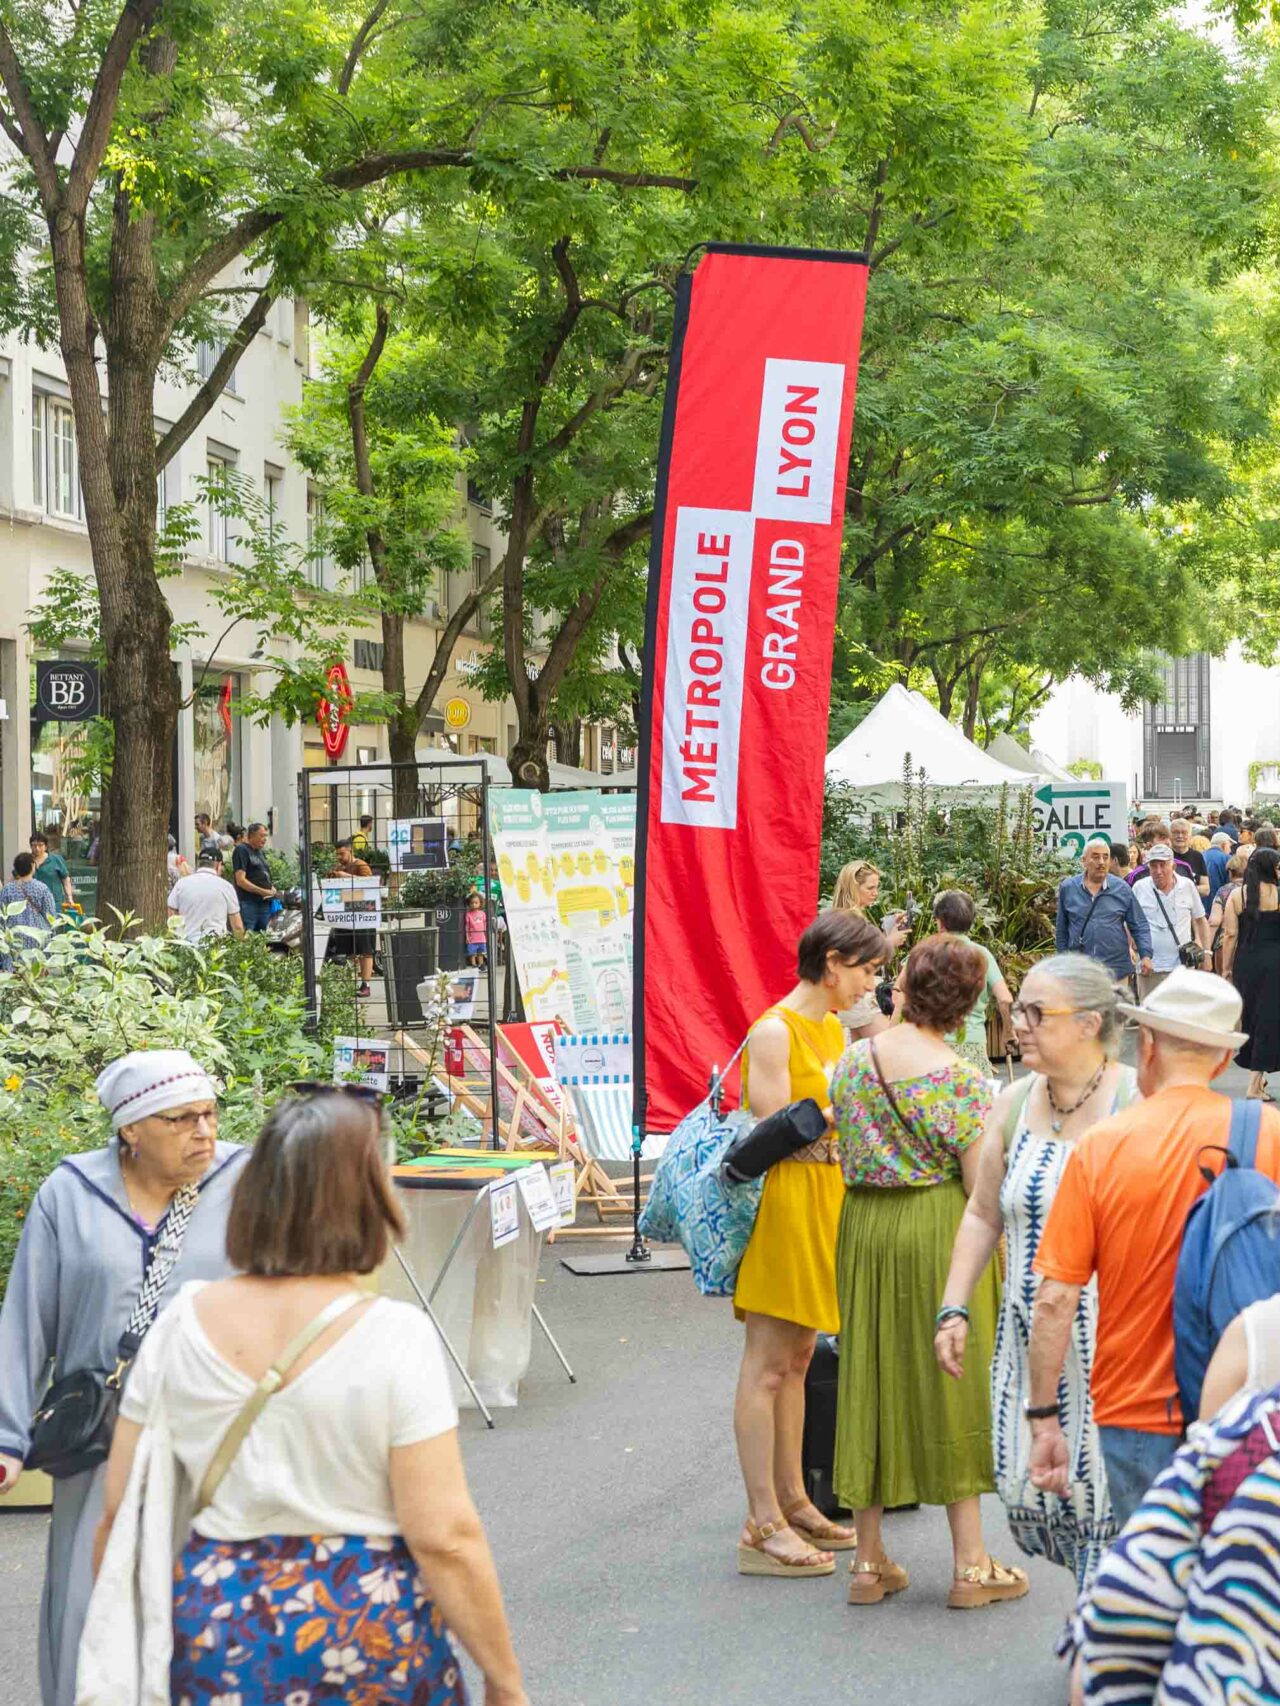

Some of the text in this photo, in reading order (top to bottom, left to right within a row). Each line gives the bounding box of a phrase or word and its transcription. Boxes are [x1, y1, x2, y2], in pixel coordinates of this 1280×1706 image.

[776, 384, 820, 498] LYON
[761, 538, 805, 690] GRAND
[50, 673, 84, 681] BETTANT
[681, 532, 731, 803] MÉTROPOLE
[50, 680, 85, 705] BB
[1031, 804, 1112, 833] SALLE
[358, 913, 377, 922] Pizza
